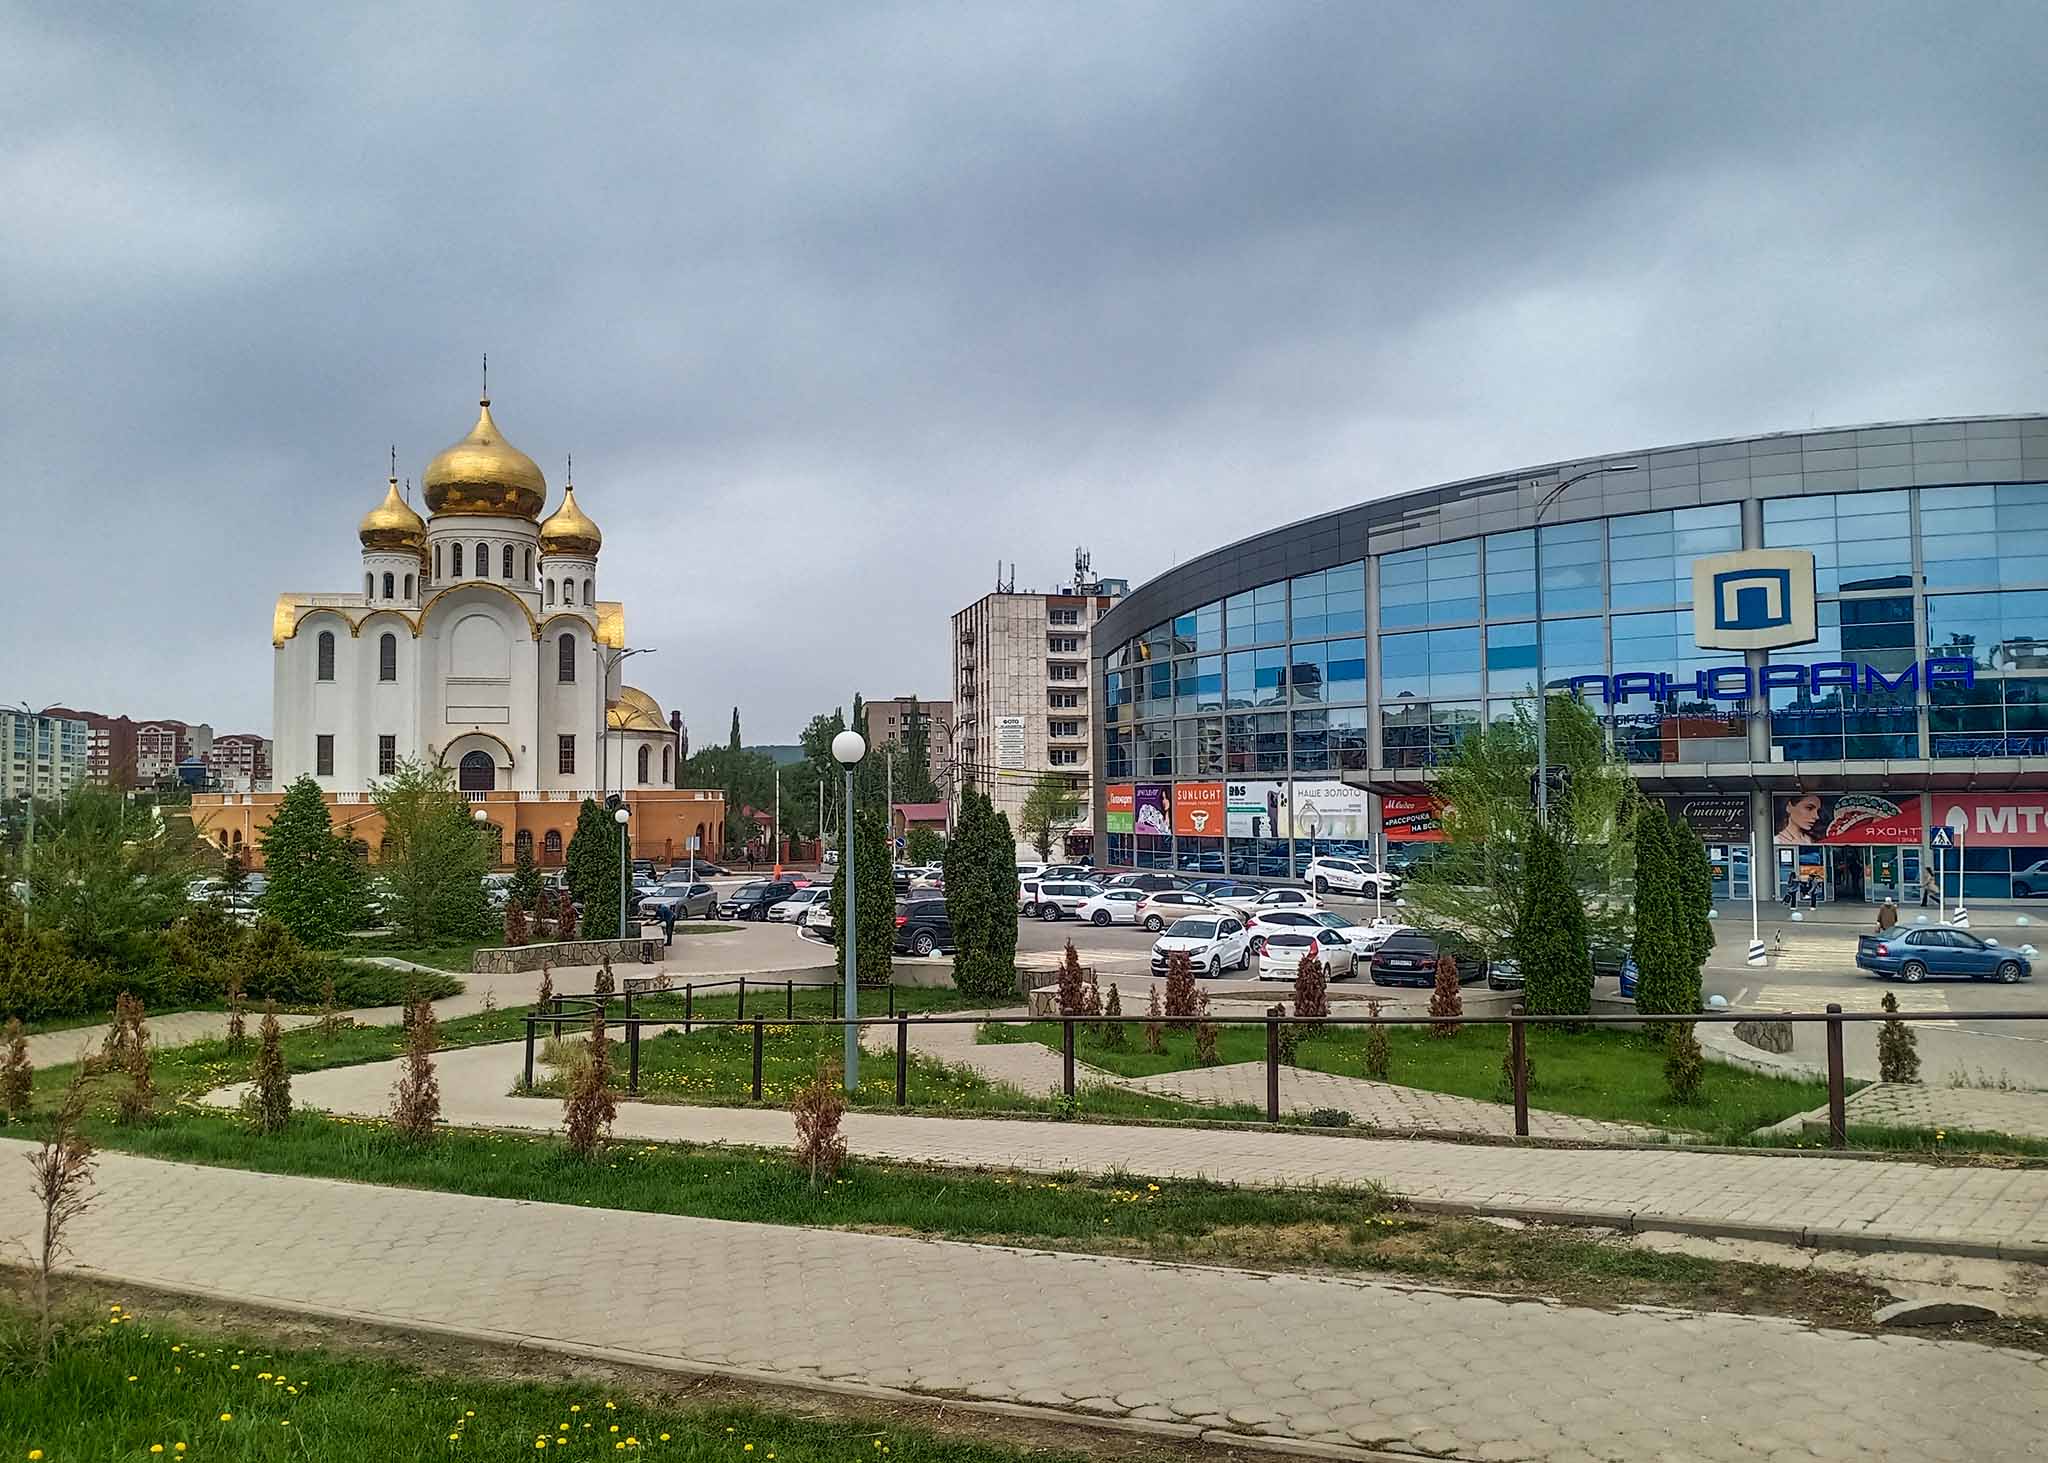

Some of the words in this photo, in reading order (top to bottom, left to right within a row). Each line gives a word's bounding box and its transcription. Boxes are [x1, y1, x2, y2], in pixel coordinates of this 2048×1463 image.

[1177, 790, 1221, 801] SUNLIGHT
[1298, 789, 1321, 798] НАШЕ
[1324, 788, 1361, 798] ЗОЛОТО
[1683, 801, 1745, 822] Статус
[1975, 806, 2048, 834] МТ
[1411, 824, 1422, 832] НА
[1865, 827, 1919, 837] ЯХОНТ
